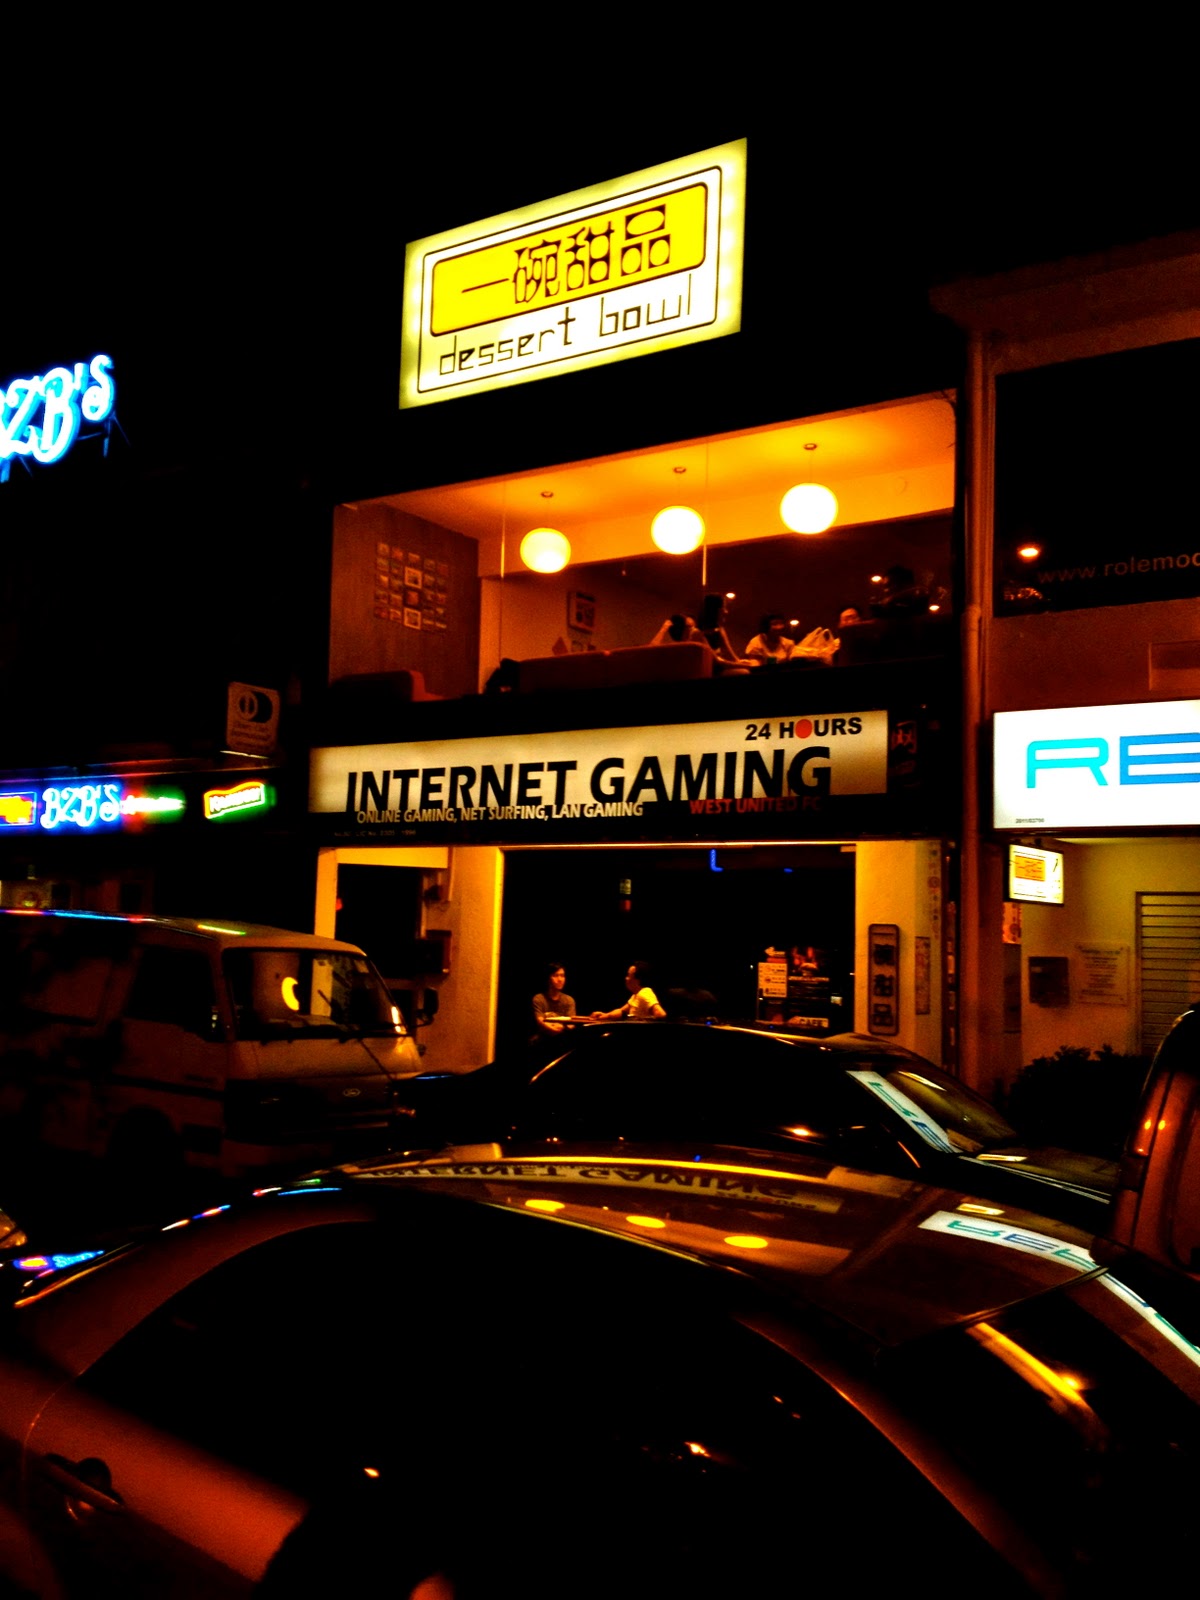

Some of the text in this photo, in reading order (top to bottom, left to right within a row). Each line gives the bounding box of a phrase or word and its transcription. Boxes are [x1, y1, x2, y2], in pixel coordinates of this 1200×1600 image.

[461, 204, 671, 305] 一碗甜品
[439, 273, 693, 376] dessert bowl
[0, 354, 114, 463] ZB'S
[744, 716, 863, 741] 24 HOURS
[346, 745, 831, 812] INTERNET GAMING
[689, 798, 733, 815] WEST
[735, 796, 798, 813] UNITED
[356, 801, 644, 824] ONLINE GAMING, NET SURFING, LAN GAMING
